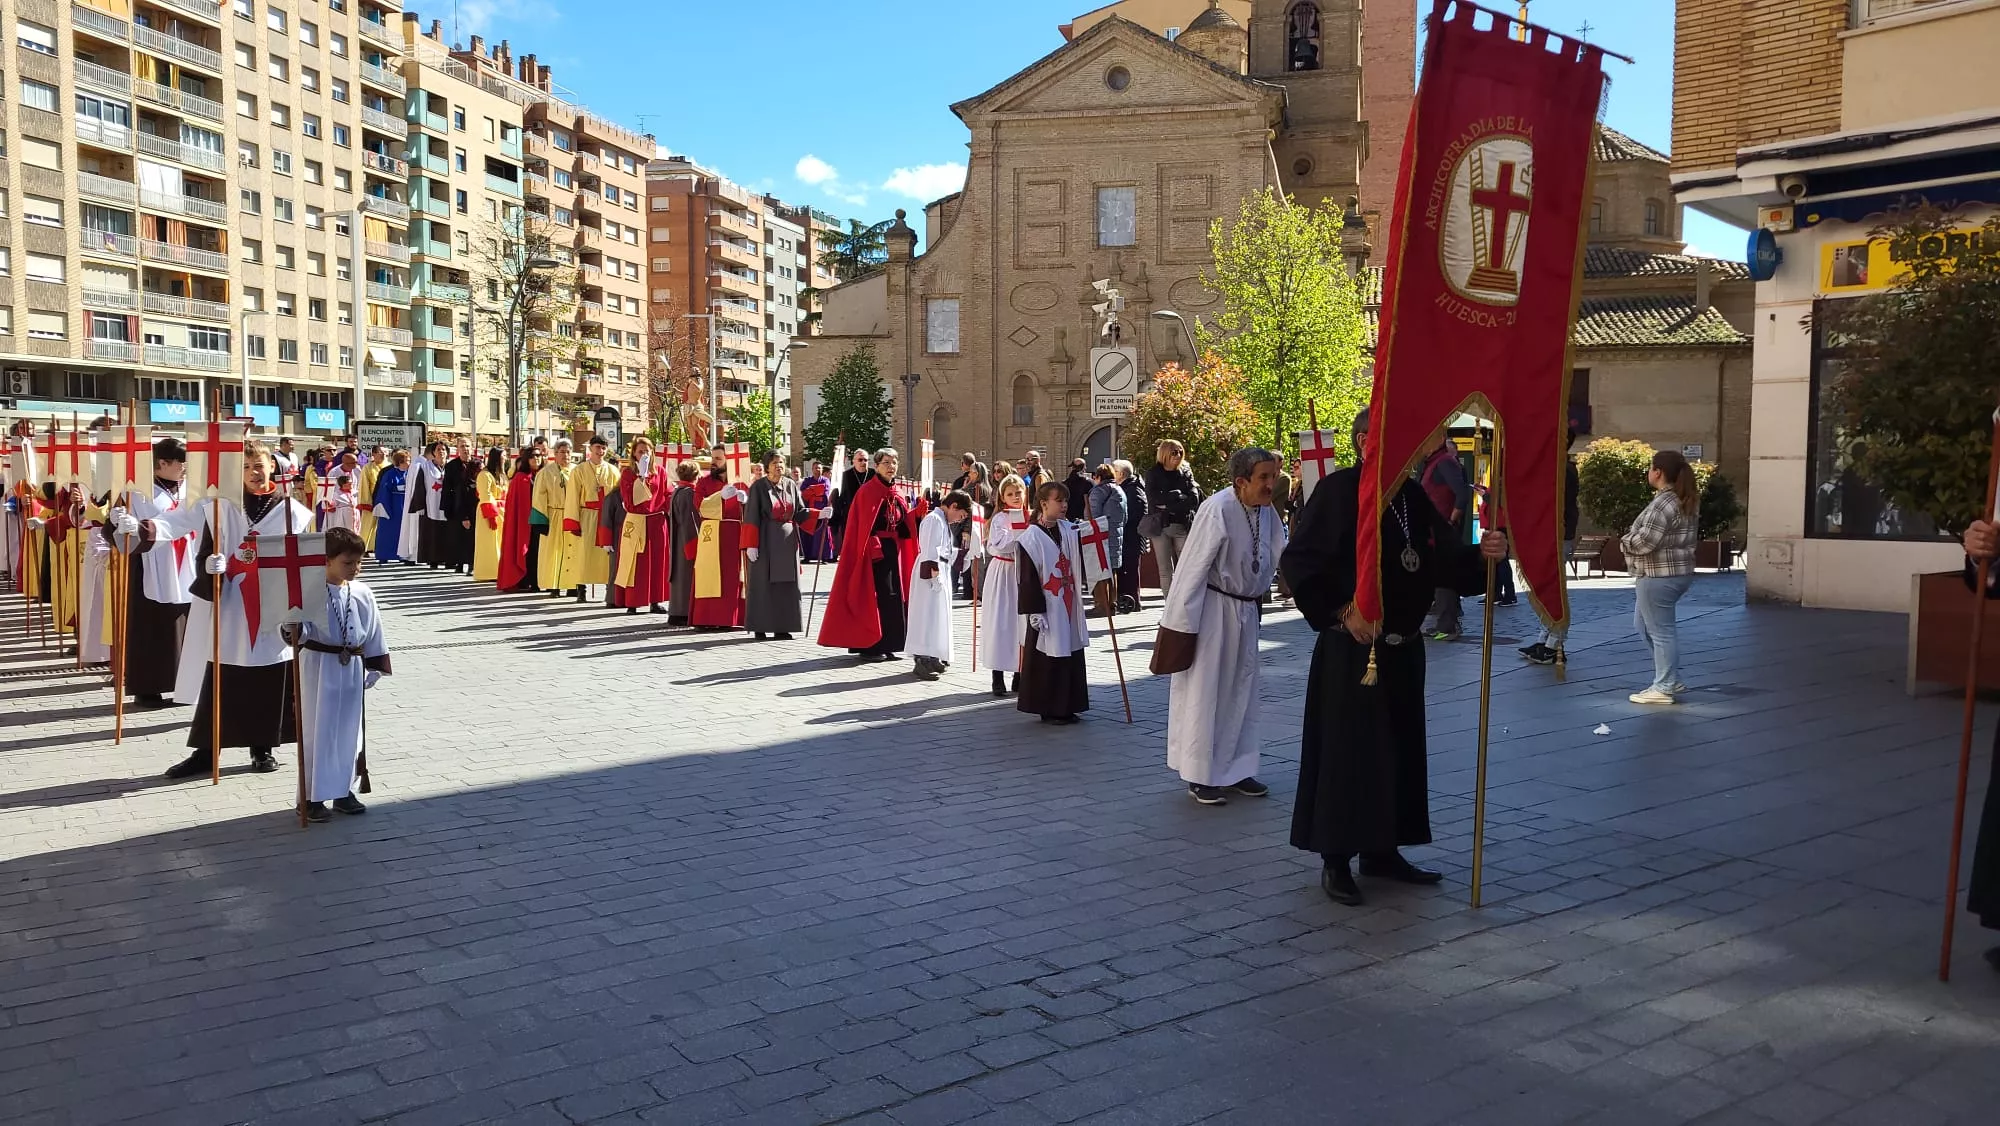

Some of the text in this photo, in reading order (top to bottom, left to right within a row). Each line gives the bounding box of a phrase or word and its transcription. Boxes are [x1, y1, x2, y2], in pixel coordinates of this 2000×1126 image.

[1425, 115, 1534, 230] ARCHICOFRADIA DE LA
